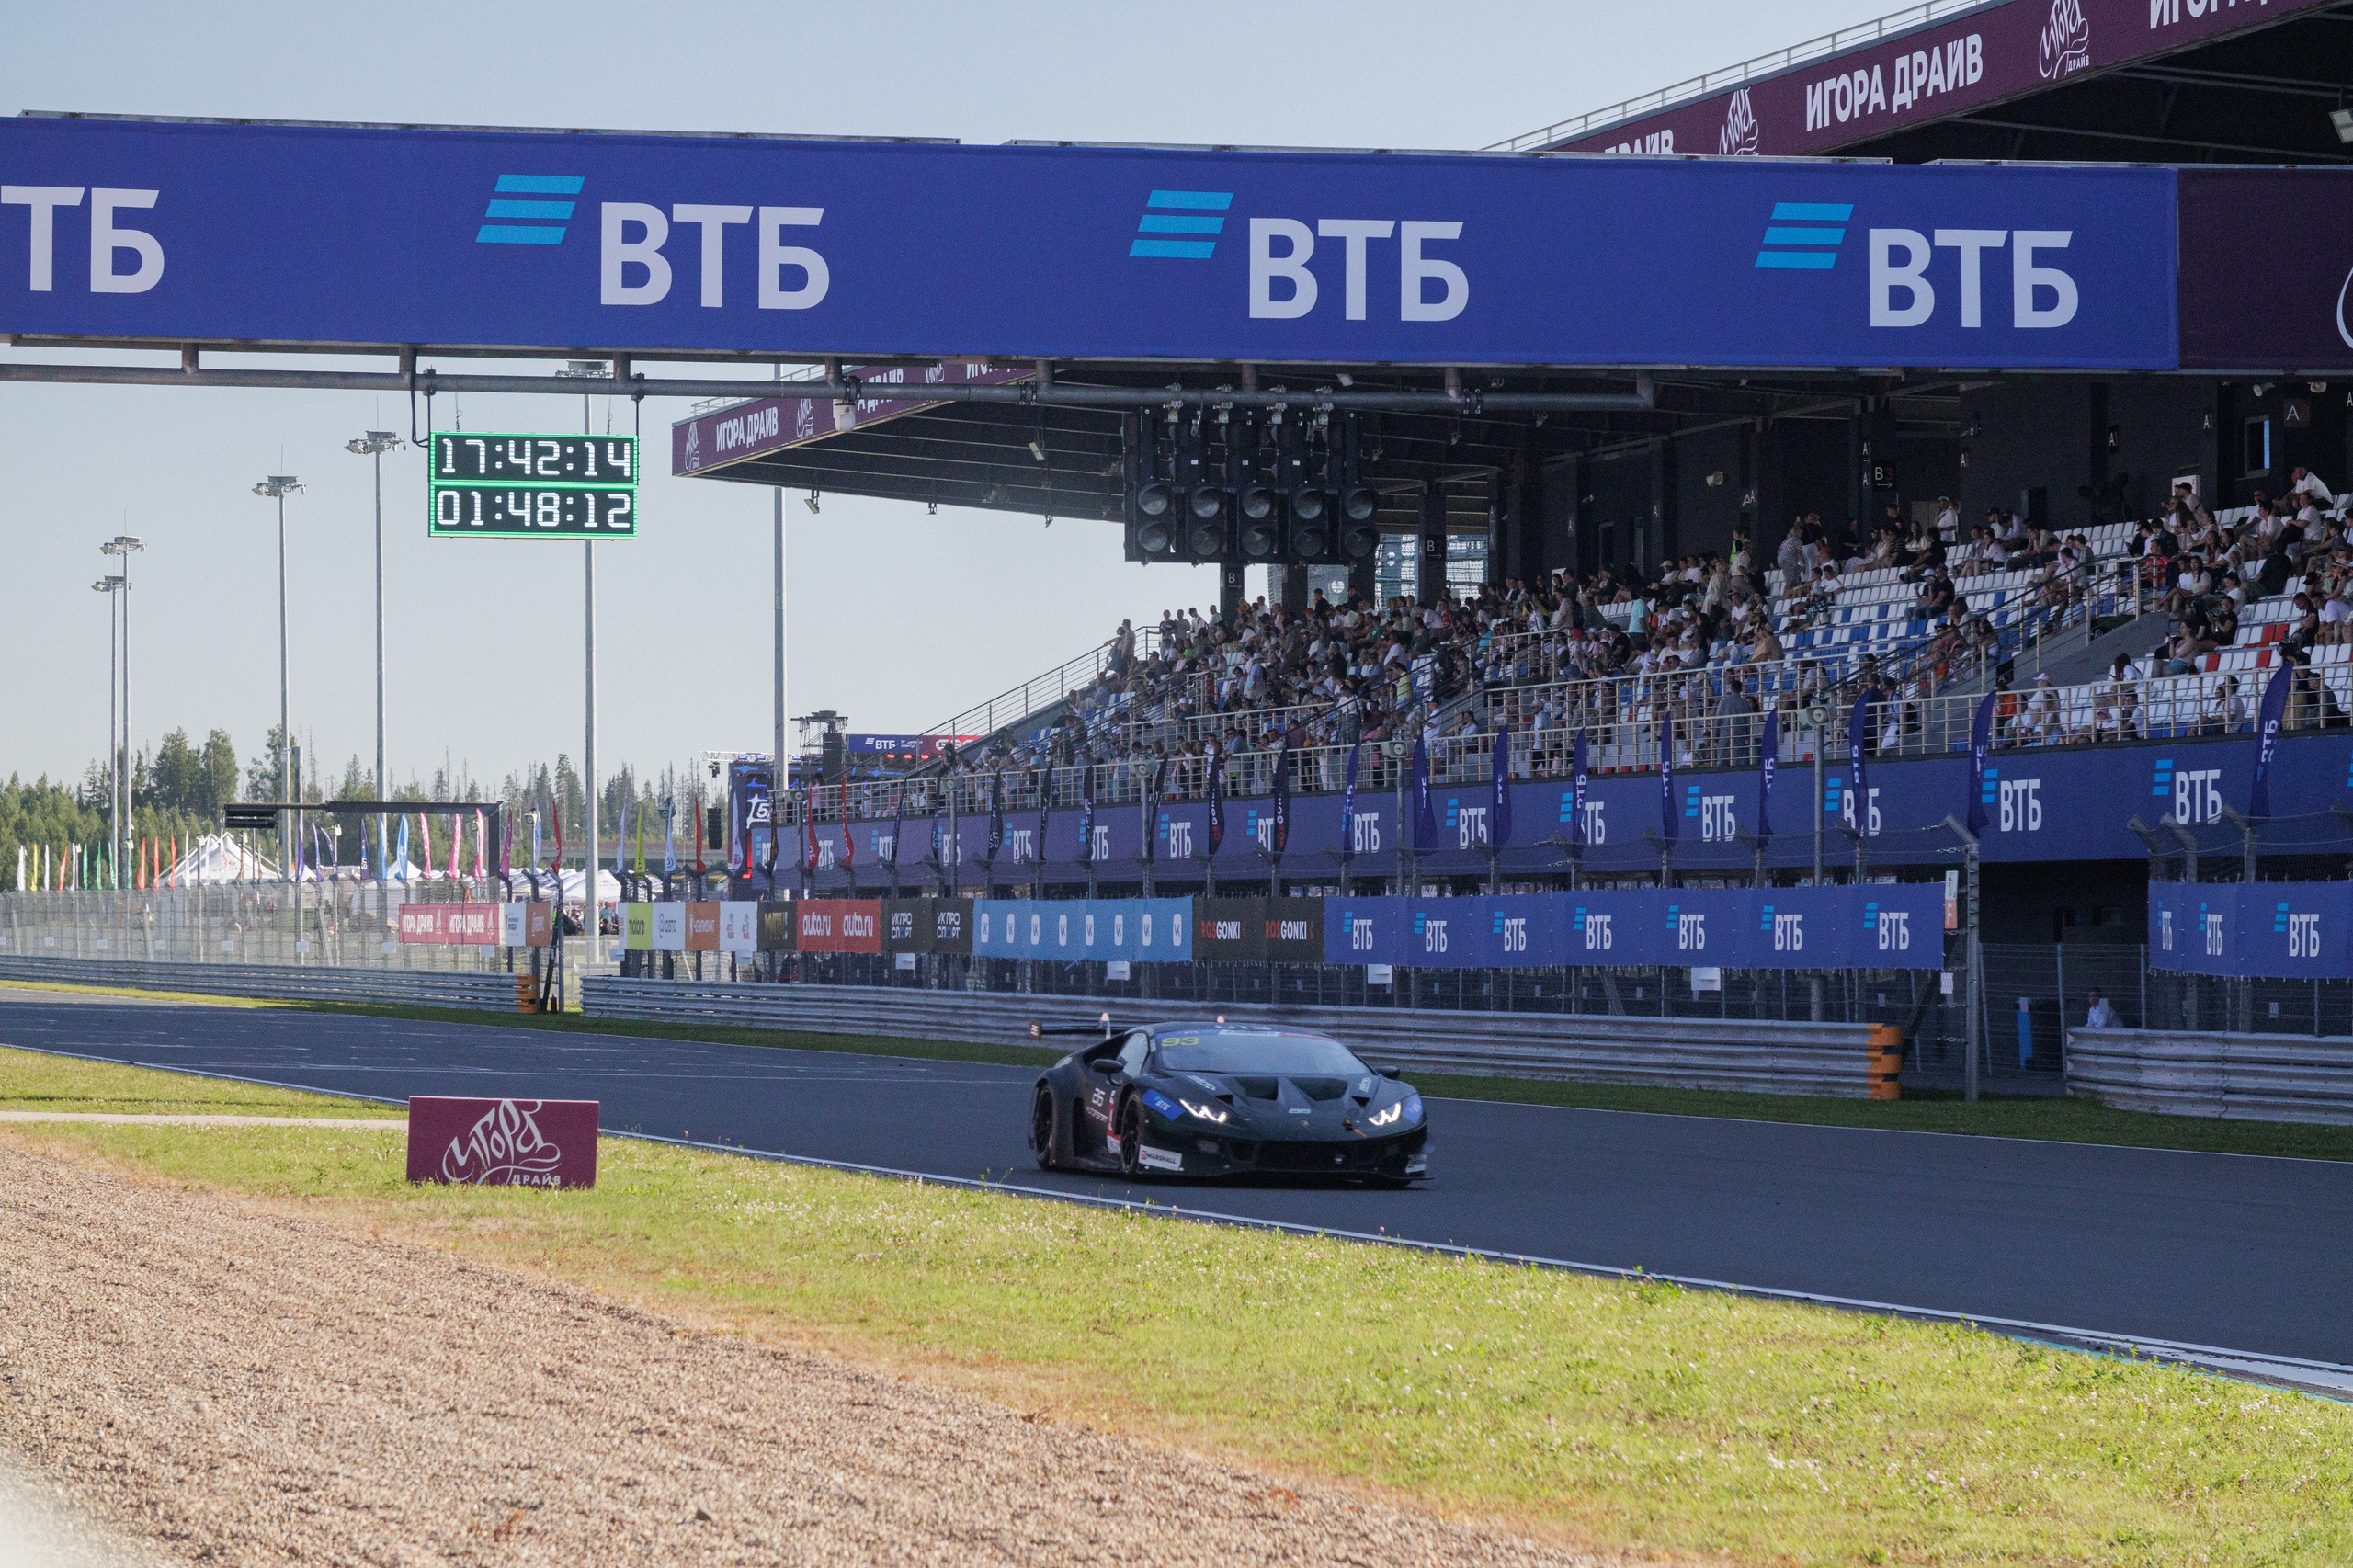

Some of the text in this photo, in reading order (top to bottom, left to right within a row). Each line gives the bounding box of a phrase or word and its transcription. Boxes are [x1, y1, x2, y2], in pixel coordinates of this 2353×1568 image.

[1806, 33, 1983, 131] ИГОРА ДРАЙВ
[600, 201, 830, 310] ВТБ
[1249, 217, 1469, 322] ВТБ
[1869, 228, 2079, 329] ВТБ
[716, 416, 745, 452] ИГОРА
[746, 406, 779, 448] ДРАЙВ
[442, 438, 631, 477] 17:42:14
[437, 490, 631, 528] 01:48:12
[1843, 788, 1881, 837] ВБ
[2000, 778, 2042, 832] ВТБ
[2176, 769, 2222, 824] ВТБ
[1258, 818, 1274, 857] ВТ
[1354, 812, 1380, 854] ВТБ
[1460, 807, 1487, 849] ВТБ
[1581, 801, 1606, 846] ТБ
[1702, 795, 1736, 842] ВТБ
[943, 833, 961, 867] ВБ
[1170, 822, 1192, 859] ВТБ
[802, 911, 832, 937] auto.ru
[843, 911, 874, 937] auto.ru
[1200, 920, 1241, 939] ROSGONKI
[1265, 920, 1307, 940] ROSGONKI
[1352, 919, 1373, 950] ВТБ
[1426, 920, 1448, 953] ВТБ
[1504, 918, 1527, 951] ВТБ
[1586, 915, 1612, 949] ВТБ
[1679, 914, 1705, 950] ВТБ
[1774, 914, 1803, 951] ВТБ
[1878, 912, 1910, 950] ВТБ
[2206, 913, 2222, 956] ВТБ
[2289, 914, 2320, 958] ВТБ
[1161, 1036, 1199, 1047] 93
[511, 1173, 561, 1185] ДРАЙВ
